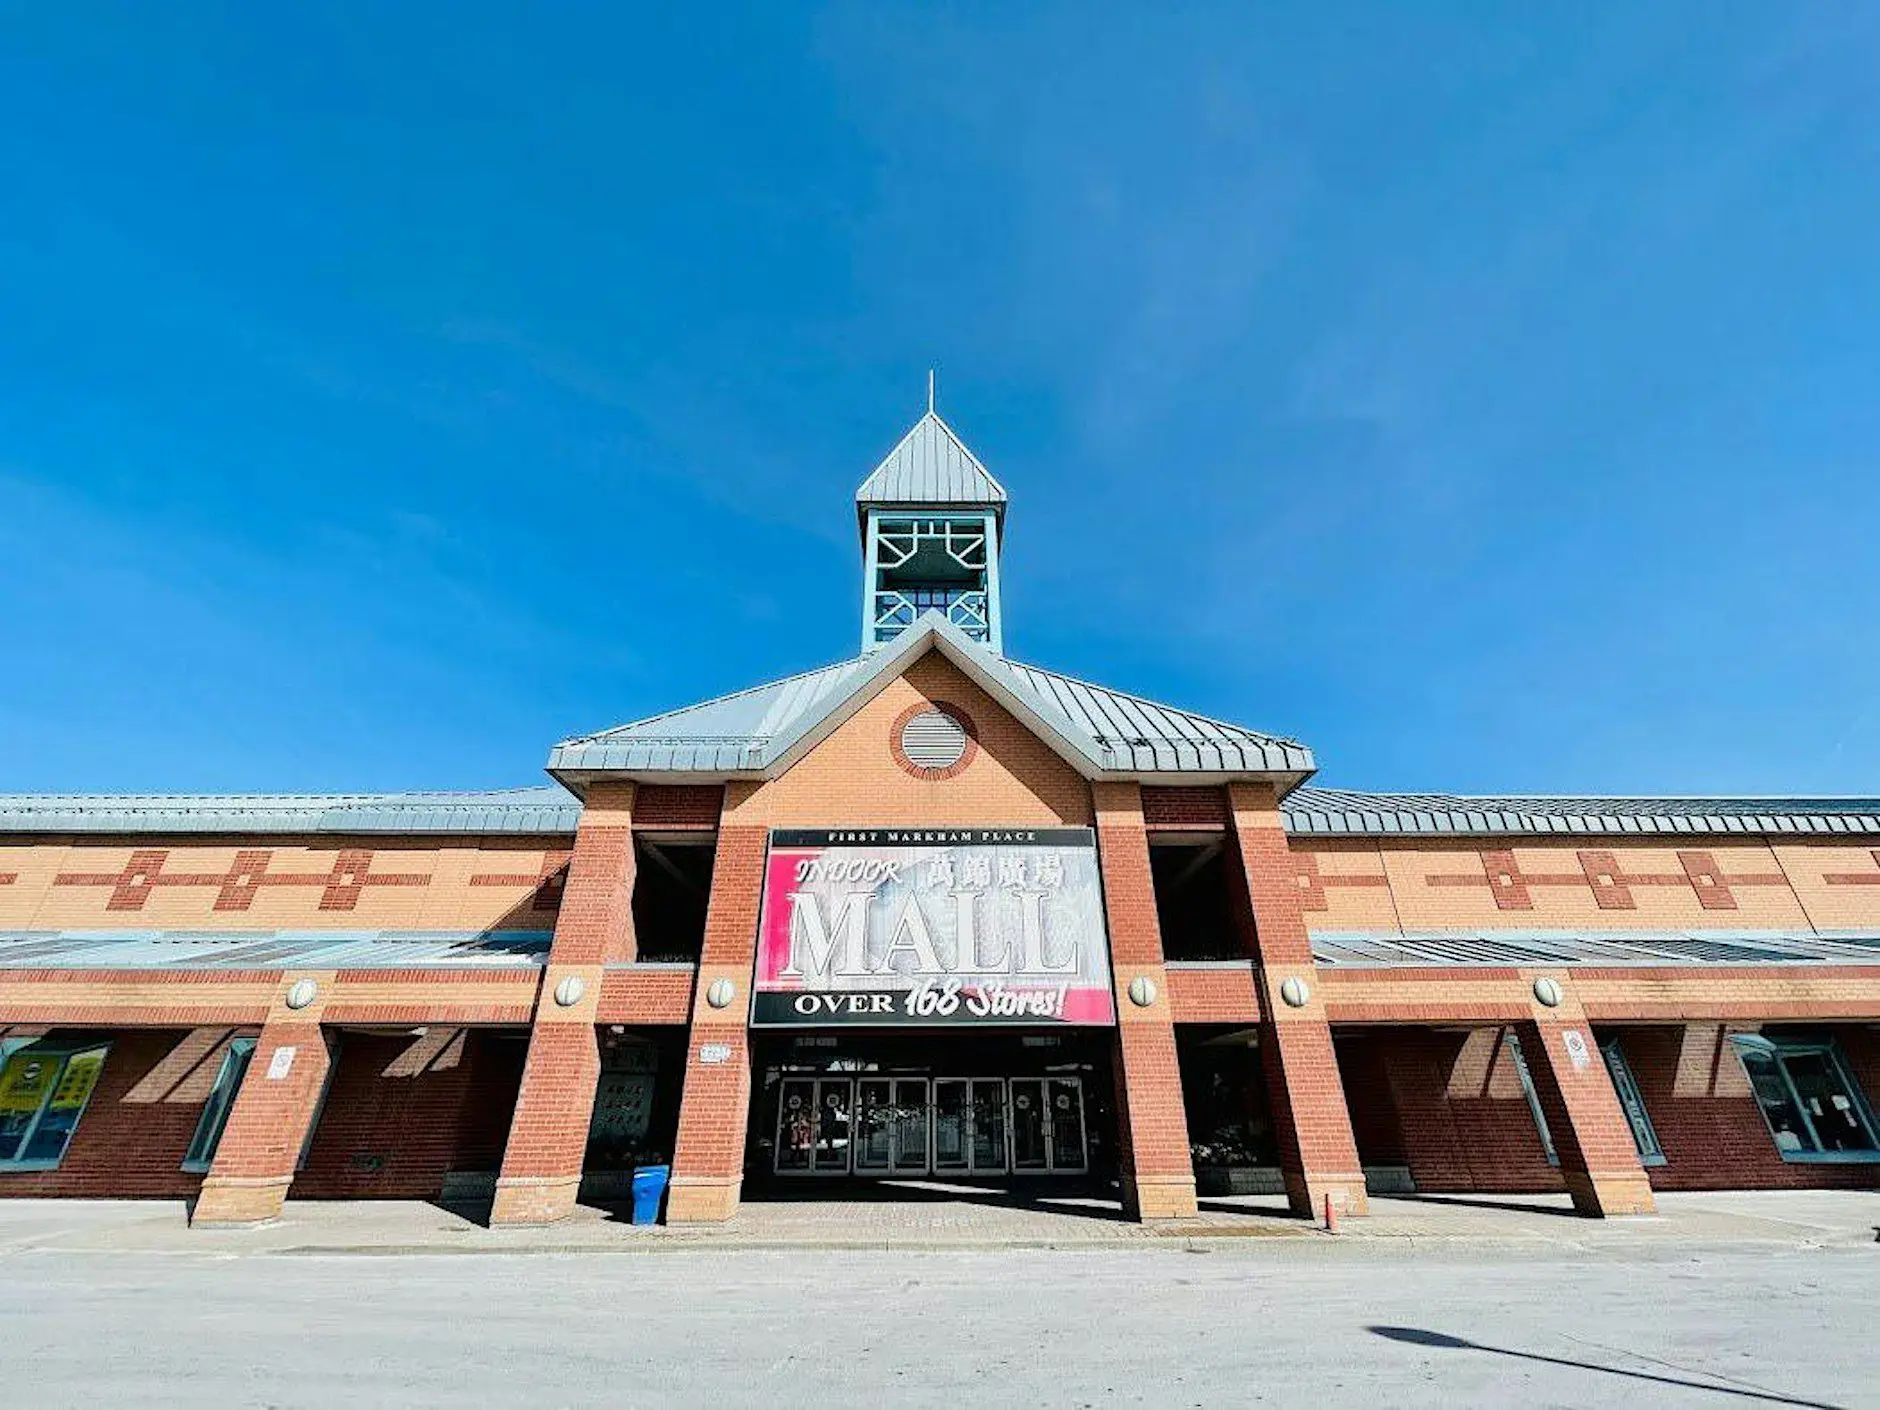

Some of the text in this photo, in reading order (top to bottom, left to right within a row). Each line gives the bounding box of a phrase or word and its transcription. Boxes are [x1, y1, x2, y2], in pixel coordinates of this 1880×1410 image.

[828, 832, 1036, 842] FIRST MARKHAM PLACE
[795, 858, 903, 884] INDOOR
[779, 889, 1078, 976] MALL
[794, 978, 1068, 1017] OVER 168 Stores!
